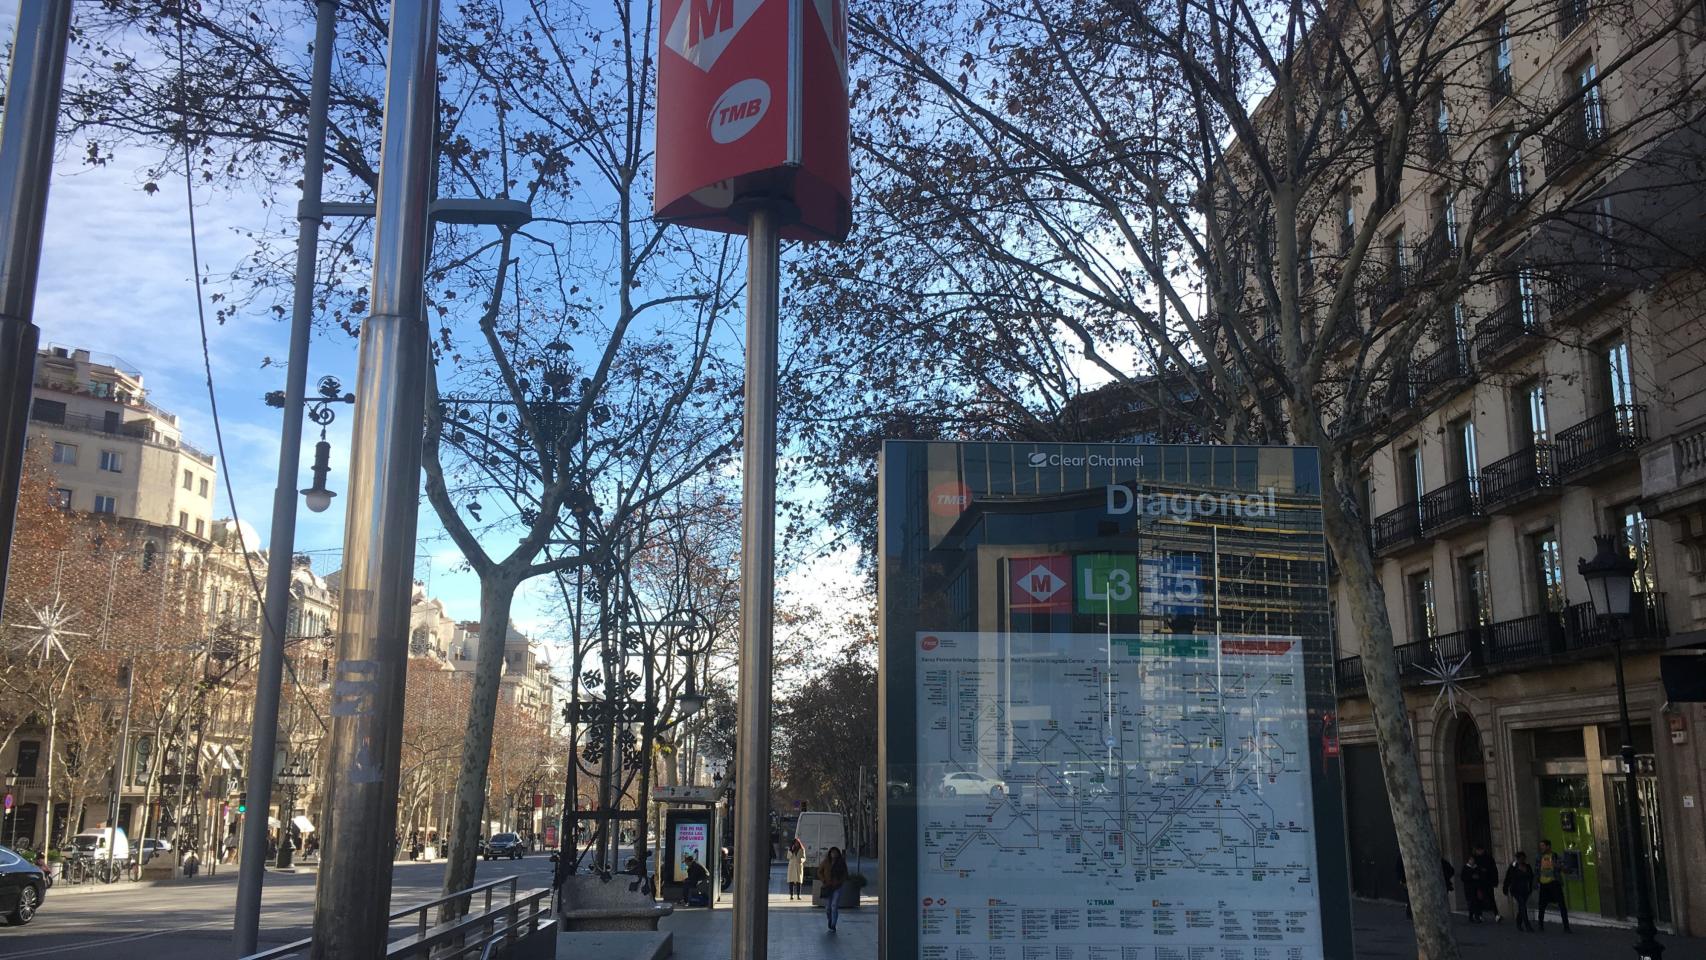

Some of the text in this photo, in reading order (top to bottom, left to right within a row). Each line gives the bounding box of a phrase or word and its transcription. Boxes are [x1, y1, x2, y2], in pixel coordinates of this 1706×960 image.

[719, 98, 762, 126] TMB
[1050, 455, 1144, 467] Clear Channel
[936, 495, 968, 505] TMB
[1107, 484, 1276, 523] Diagonal
[1031, 575, 1052, 592] M
[1085, 568, 1132, 600] L3
